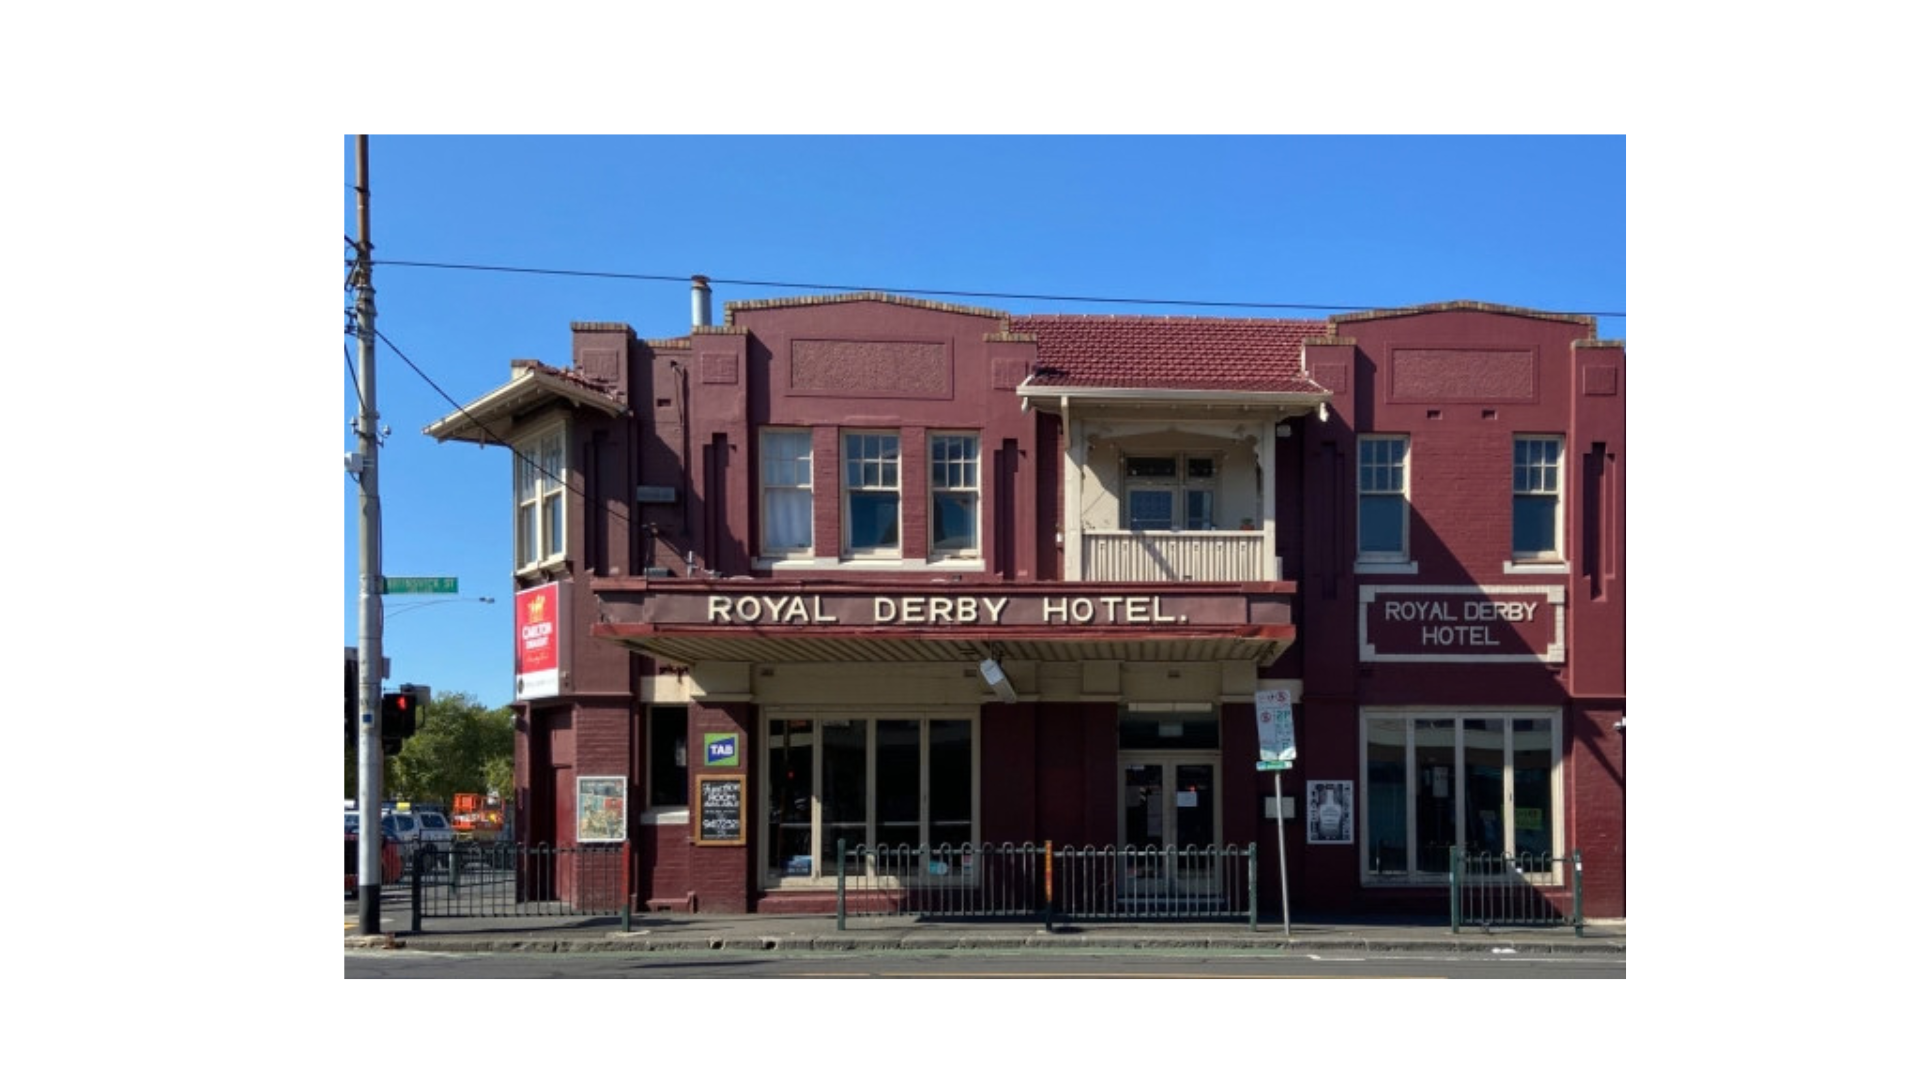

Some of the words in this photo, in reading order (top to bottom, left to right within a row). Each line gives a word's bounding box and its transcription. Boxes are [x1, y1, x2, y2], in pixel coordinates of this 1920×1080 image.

[707, 595, 838, 622] ROYAL
[873, 596, 1008, 623] DERBY
[1042, 596, 1189, 623] HOTEL.
[1385, 601, 1458, 621] ROYAL
[1464, 601, 1538, 622] DERBY
[1422, 626, 1500, 646] HOTEL
[710, 744, 733, 755] TAB
